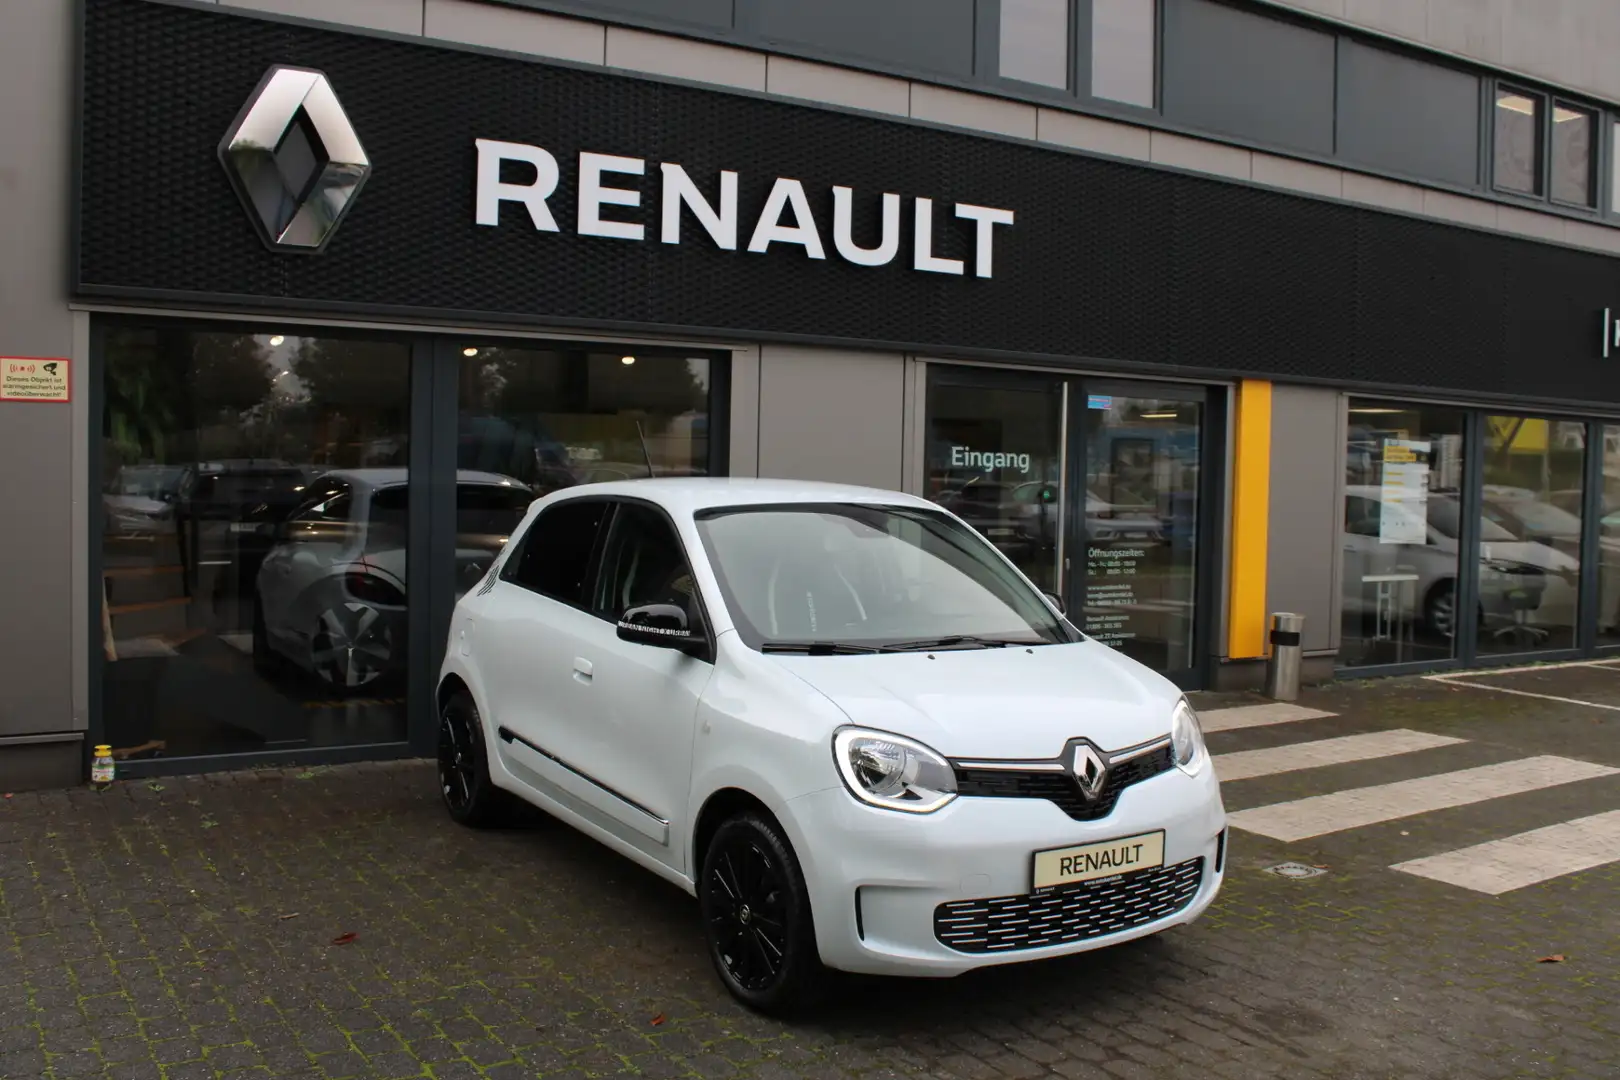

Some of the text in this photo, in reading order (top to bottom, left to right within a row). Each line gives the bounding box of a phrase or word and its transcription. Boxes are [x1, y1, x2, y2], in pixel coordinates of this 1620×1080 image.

[475, 138, 1014, 279] RENAULT
[951, 446, 1030, 473] Eingang
[1060, 844, 1143, 876] RENAULT
